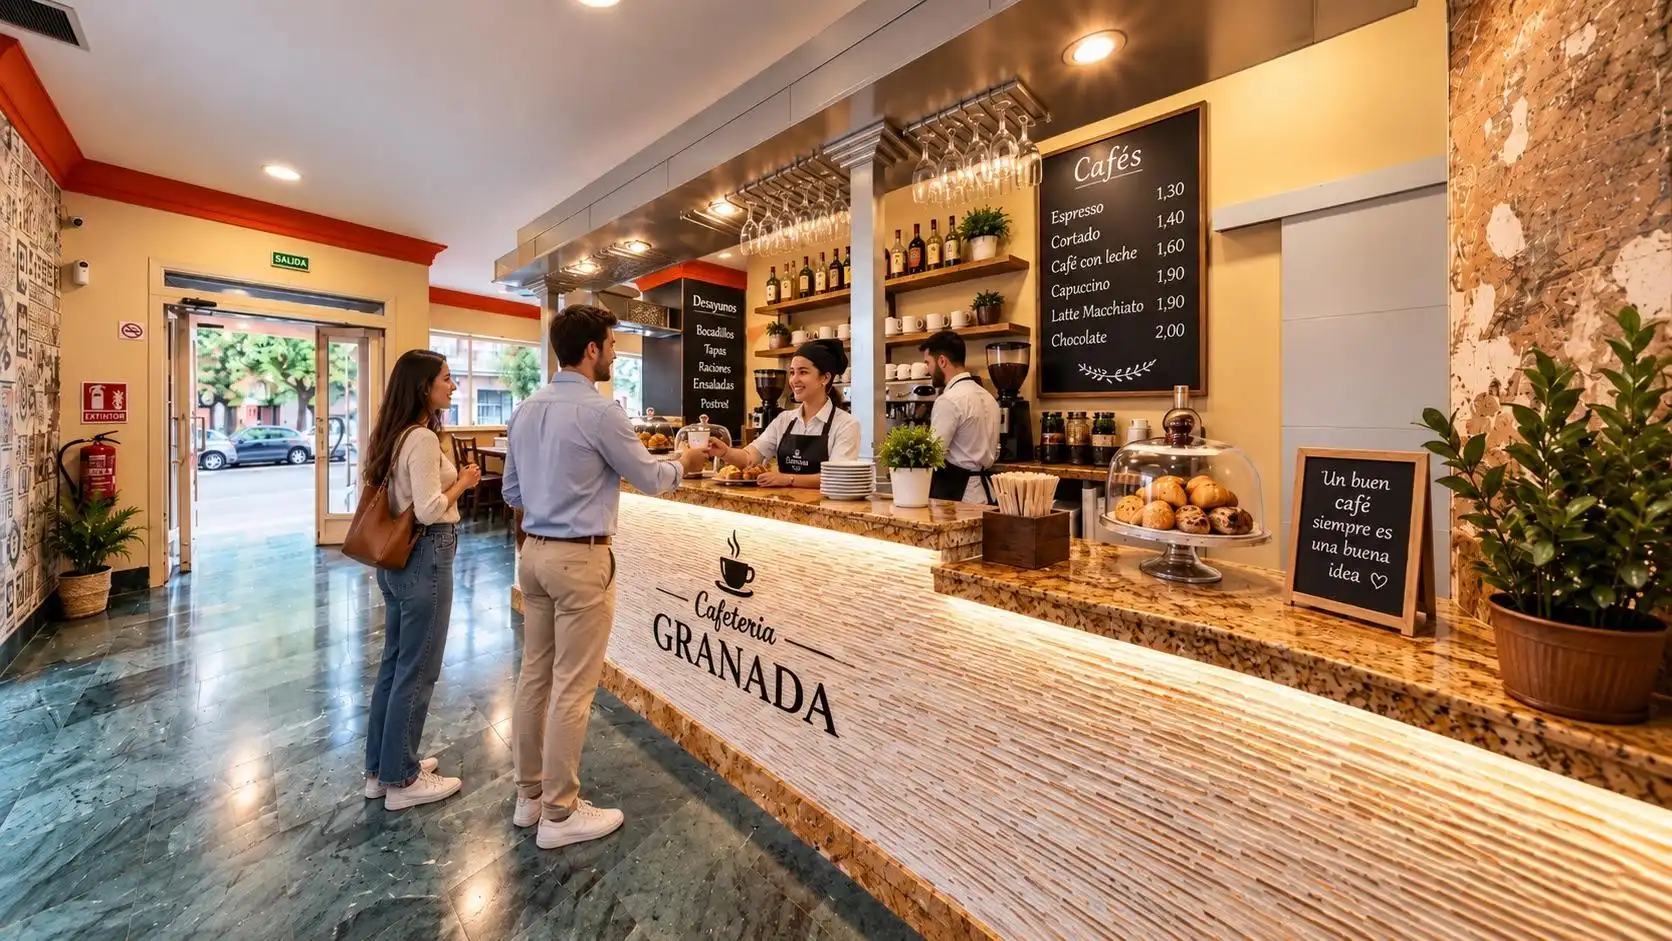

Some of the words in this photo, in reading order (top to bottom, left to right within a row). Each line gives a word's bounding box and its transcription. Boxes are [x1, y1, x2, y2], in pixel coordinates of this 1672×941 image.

[1074, 145, 1142, 183] Cafés
[1051, 202, 1104, 226] Espresso
[1156, 181, 1185, 202] 1,30
[1051, 226, 1101, 249] Cortado
[1156, 210, 1185, 230] 1,40
[275, 254, 307, 267] SALIDA
[1051, 255, 1077, 275] Café
[1080, 254, 1102, 267] con
[1105, 246, 1137, 263] leche
[1156, 238, 1185, 257] 1,60
[1051, 279, 1110, 300] Capuccino
[1156, 266, 1185, 285] 1,90
[693, 294, 737, 314] Desayunos
[1051, 309, 1080, 322] Latte
[1082, 300, 1144, 319] Macchiato
[1156, 294, 1185, 313] 1,90
[696, 324, 735, 340] Bocadillos
[1051, 329, 1108, 348] Chocolate
[1155, 322, 1185, 340] 2,00
[703, 344, 727, 358] Tapas
[698, 361, 732, 374] Raciones
[693, 377, 735, 391] Ensaladas
[85, 412, 126, 421] EXTINTOR
[1321, 470, 1346, 487] Un
[1351, 470, 1390, 491] buen
[1335, 494, 1371, 517] café
[1312, 515, 1371, 538] siempre
[1375, 527, 1393, 540] es
[1311, 540, 1338, 555] una
[1343, 539, 1390, 564] buena
[1328, 562, 1361, 583] idea
[694, 590, 777, 646] Cafeteria
[653, 613, 839, 738] GRANADA
